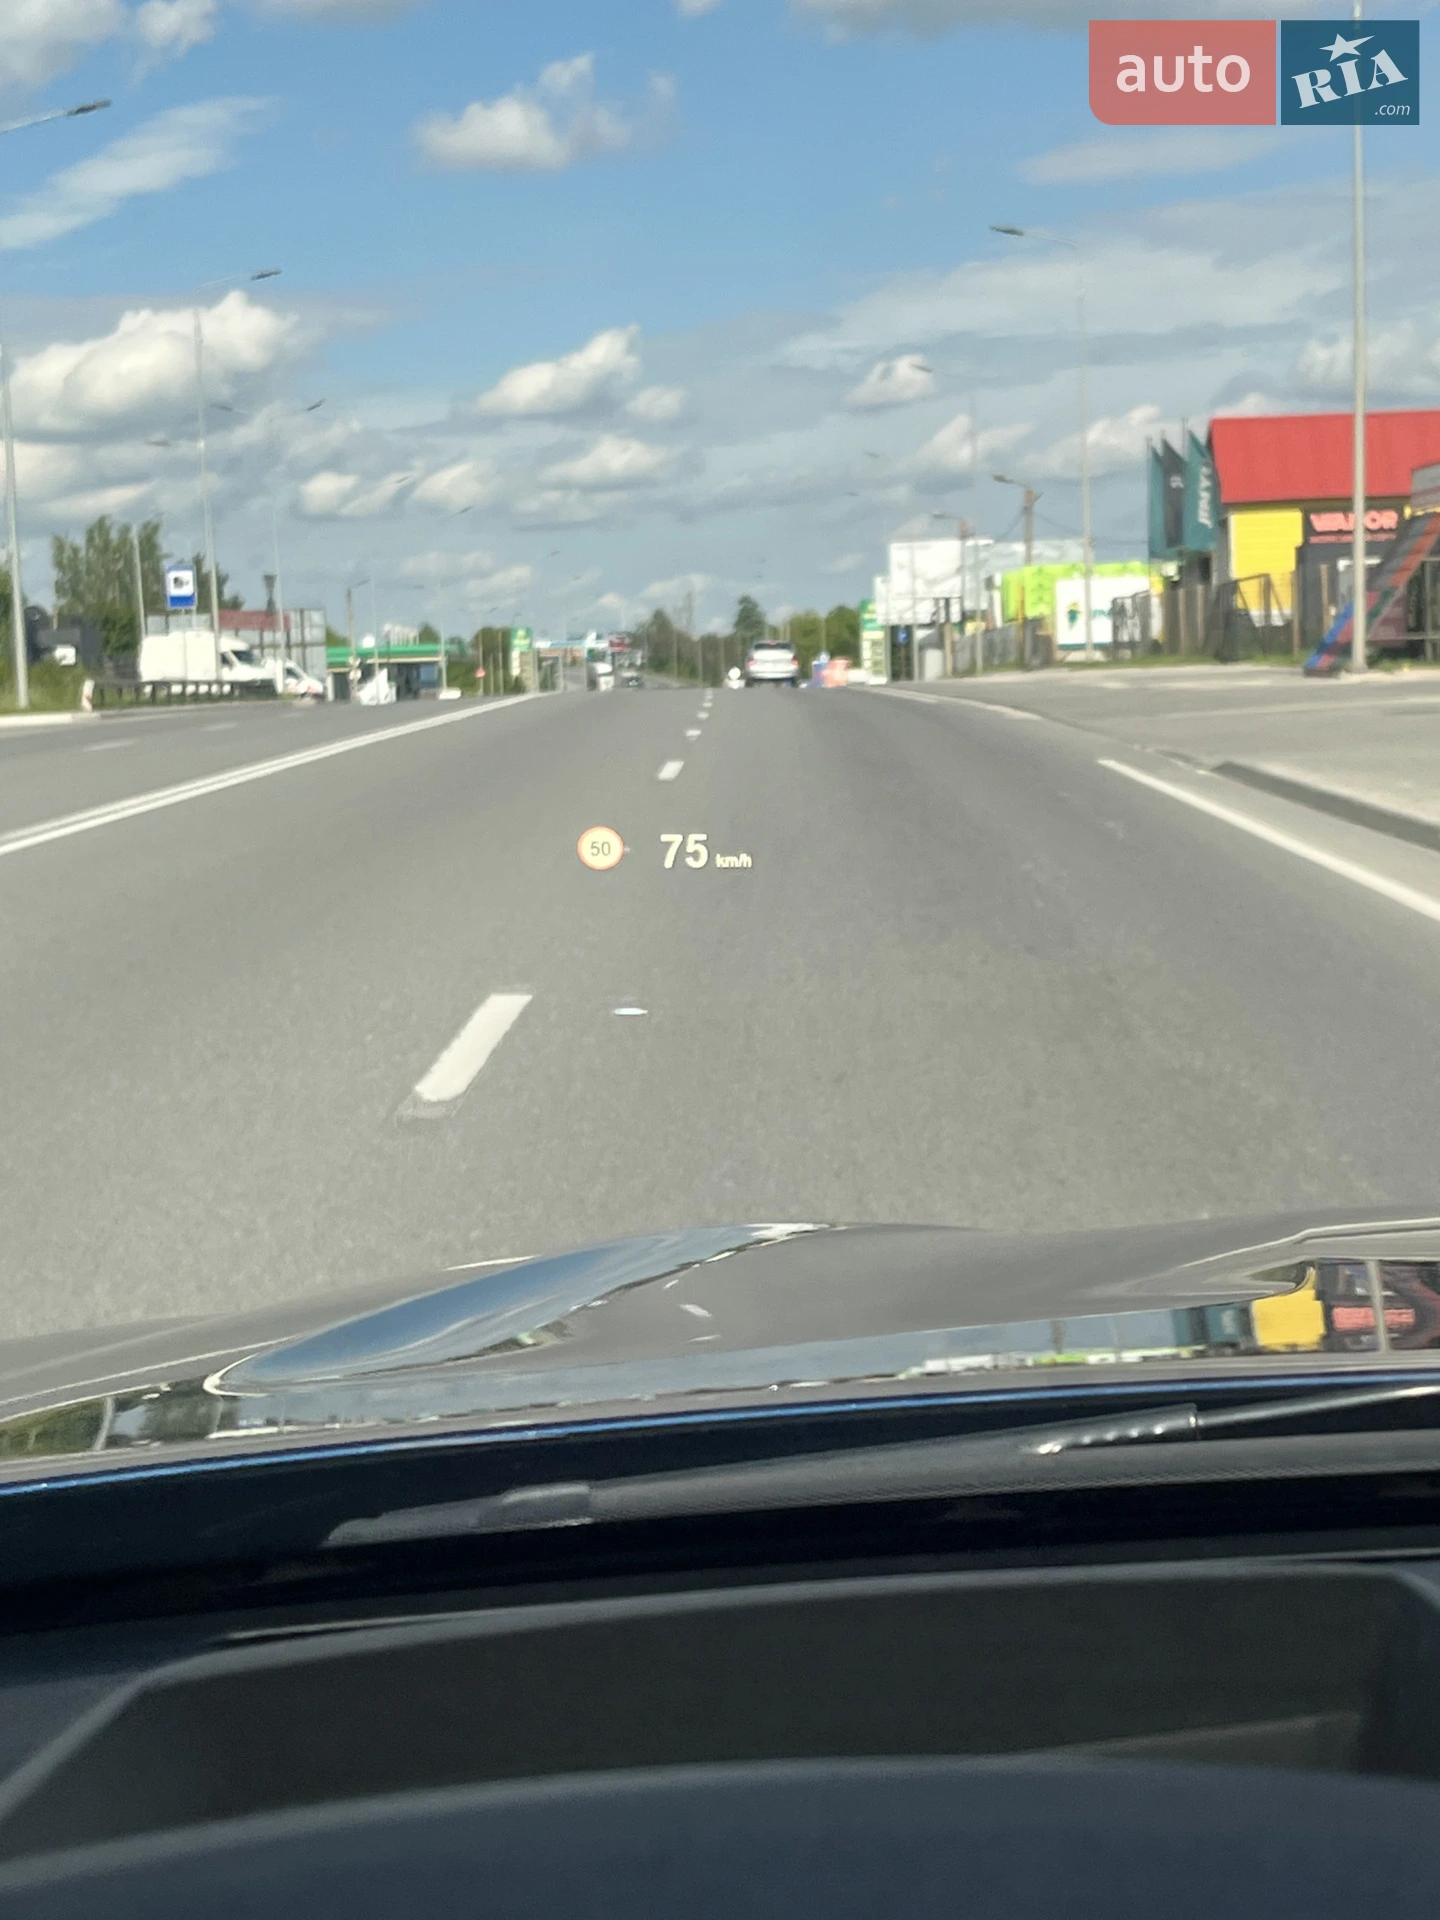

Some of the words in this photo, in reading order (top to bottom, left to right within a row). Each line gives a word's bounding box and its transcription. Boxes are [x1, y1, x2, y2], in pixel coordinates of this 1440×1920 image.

[590, 841, 611, 857] 50
[660, 833, 709, 869] 75
[715, 853, 753, 868] km/h
